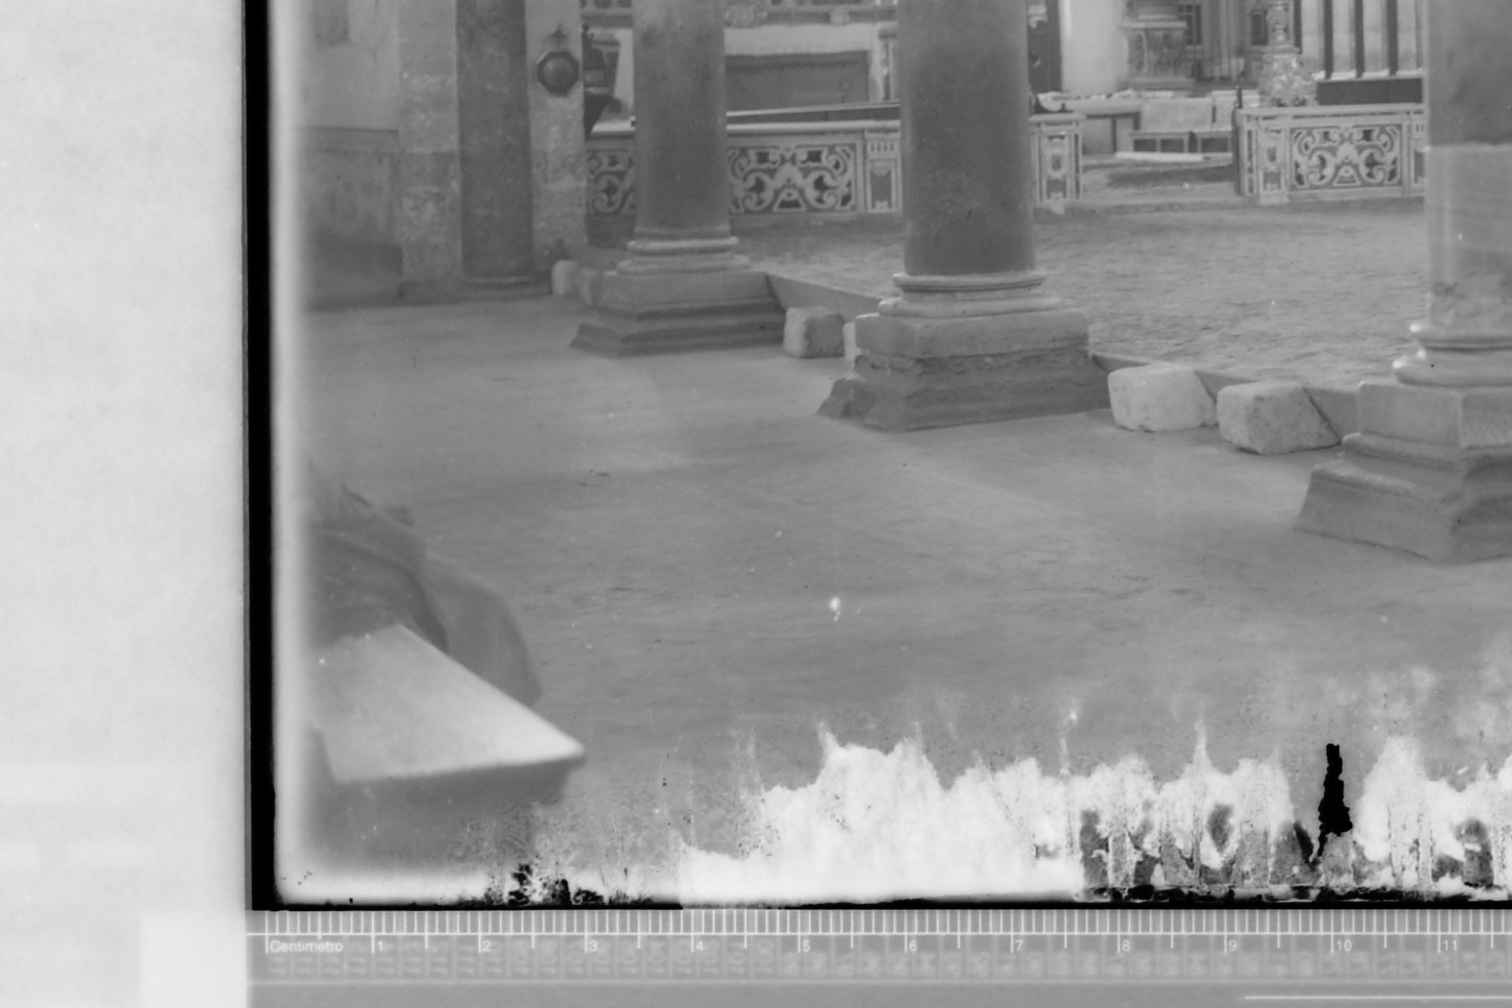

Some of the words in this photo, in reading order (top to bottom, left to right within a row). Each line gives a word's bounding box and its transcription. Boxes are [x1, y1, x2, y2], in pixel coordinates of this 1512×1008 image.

[378, 940, 384, 952] 1
[482, 940, 491, 952] 2
[589, 940, 598, 952] 3
[696, 940, 704, 952] 4
[802, 940, 811, 952] 5
[909, 940, 918, 952] 6
[1015, 940, 1024, 952] 7
[1121, 940, 1131, 952] 8
[1228, 940, 1238, 952] 9
[1337, 940, 1352, 952] 10
[1442, 940, 1458, 952] 11
